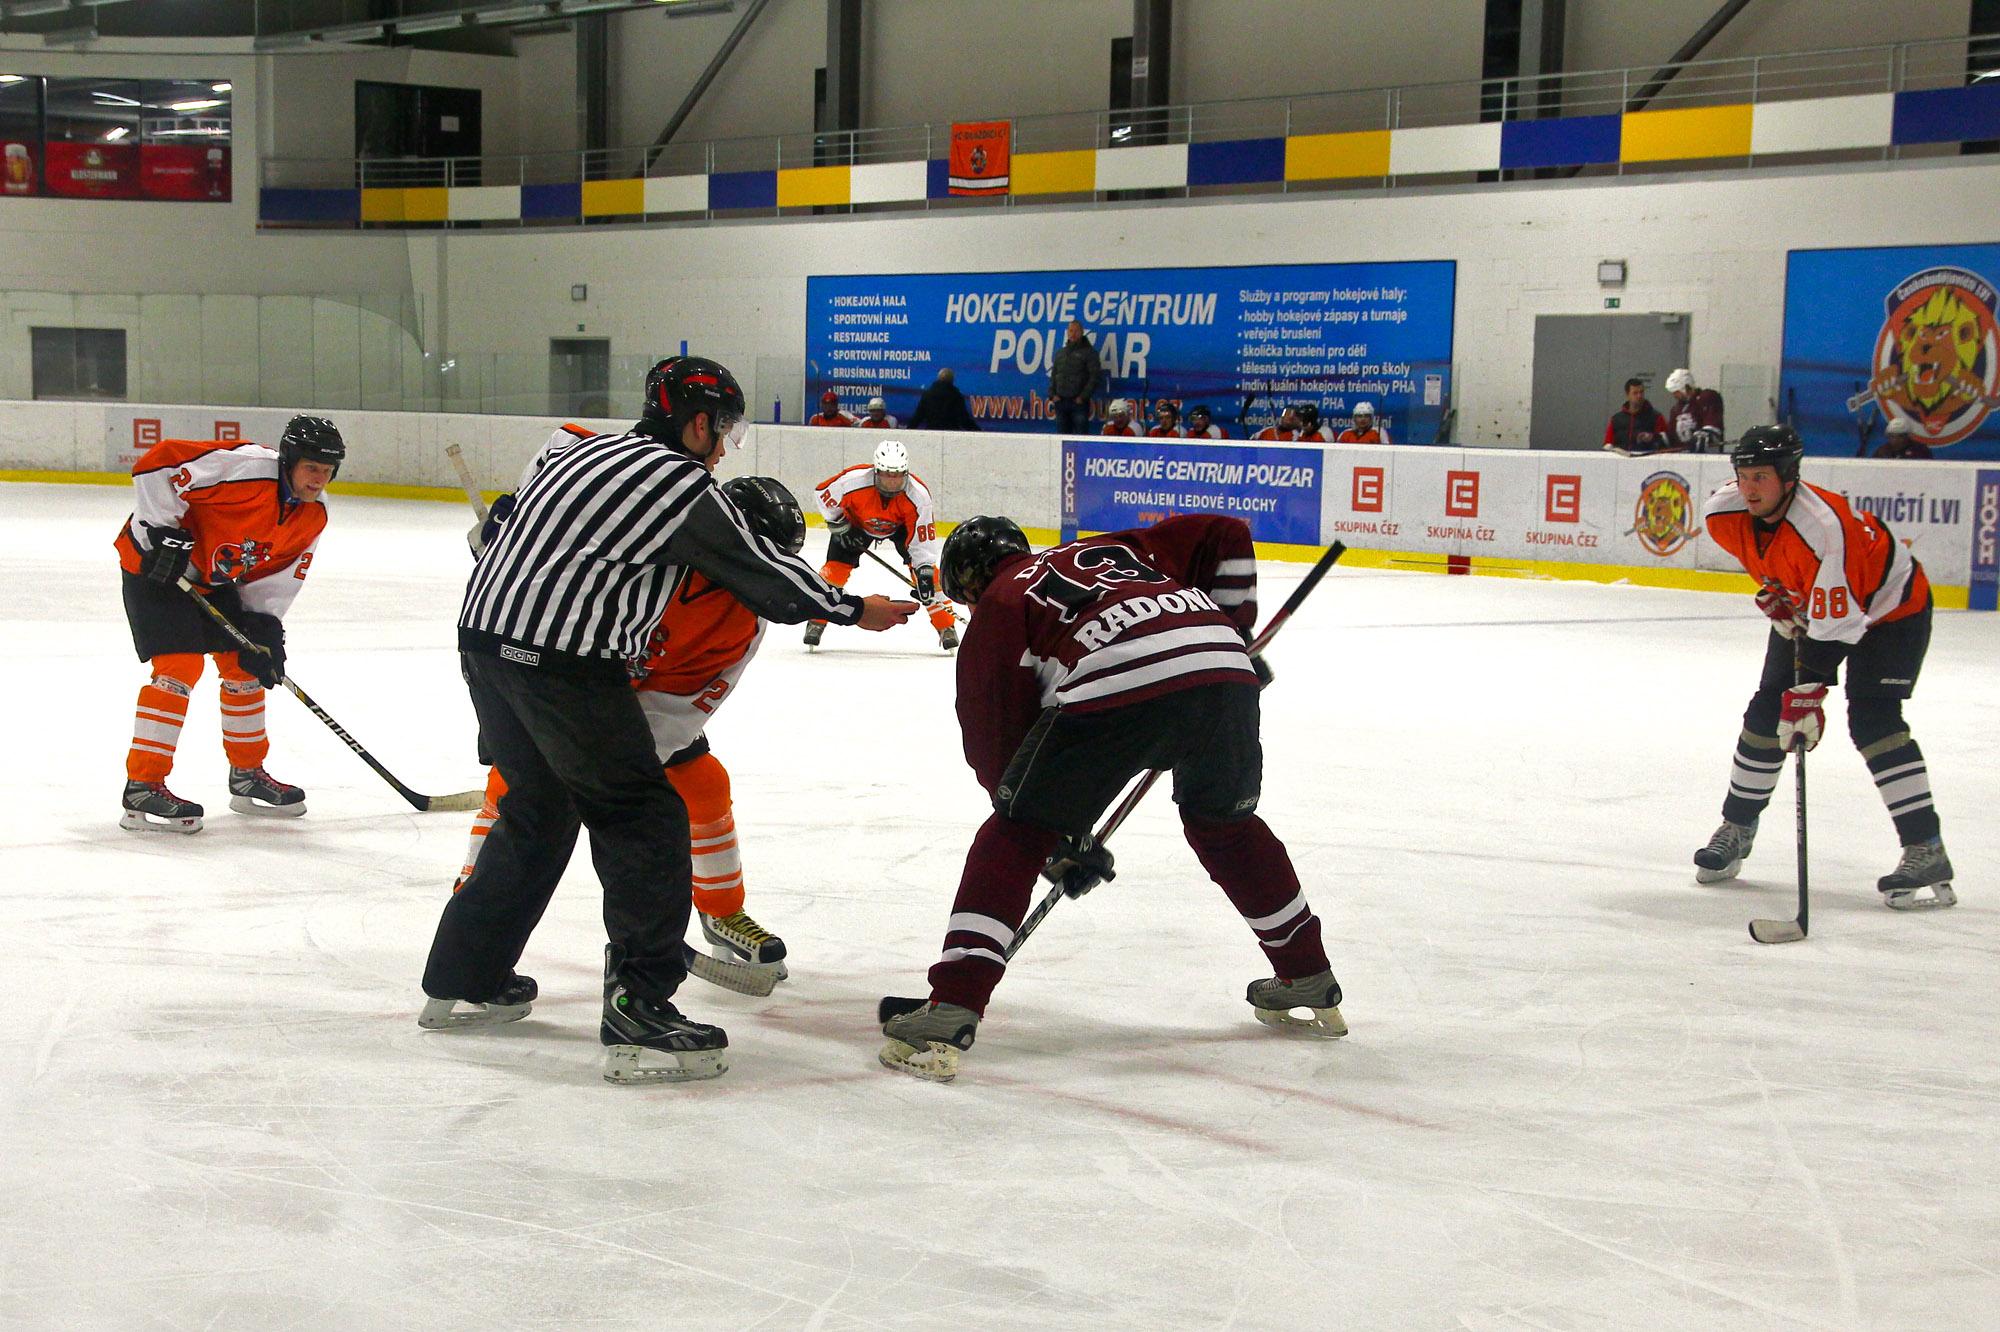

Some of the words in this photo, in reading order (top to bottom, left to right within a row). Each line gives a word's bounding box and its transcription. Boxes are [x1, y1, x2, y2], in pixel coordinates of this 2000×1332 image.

[834, 293, 881, 307] HOKEJOVÁ
[883, 295, 907, 307] HALA
[945, 284, 1078, 323] HOKEJOVÉ
[1083, 291, 1217, 325] CENTRUM
[1239, 289, 1272, 305] Služby
[1274, 292, 1281, 302] a
[1282, 290, 1330, 304] programy
[1332, 287, 1379, 303] hokejové
[1381, 287, 1407, 303] haly:
[833, 312, 883, 325] SPORTOVNÍ
[885, 314, 909, 325] HALA
[1243, 309, 1275, 325] hobby
[1276, 309, 1321, 325] hokejové
[1324, 308, 1359, 324] zápasy
[1361, 311, 1368, 321] a
[1370, 308, 1407, 324] turnaje
[833, 332, 890, 343] RESTAURACE
[1243, 326, 1279, 342] veřejné
[1281, 326, 1322, 339] bruslení
[833, 347, 882, 361] SPORTOVNÍ
[884, 350, 931, 361] PRODEJNA
[1243, 344, 1283, 358] školička
[1285, 344, 1325, 357] bruslení
[1327, 347, 1344, 359] pro
[1347, 344, 1367, 357] děti
[833, 366, 877, 378] BRUSÍRNA
[879, 367, 911, 379] BRUSLÍ
[1242, 362, 1277, 375] tělesná
[1279, 361, 1321, 376] výchova
[1323, 364, 1336, 375] na
[1338, 362, 1359, 375] ledě
[1362, 364, 1379, 378] pro
[1382, 361, 1411, 378] školy
[833, 385, 882, 396] UBYTOVÁNÍ
[1300, 379, 1346, 394] hokejové
[1348, 380, 1391, 396] tréninky
[1392, 380, 1416, 393] PHA
[1322, 397, 1345, 410] PHA
[1085, 456, 1163, 480] HOKEJOVÉ
[1166, 460, 1244, 484] CENTRUM
[1246, 464, 1314, 488] POUZAR
[1065, 452, 1075, 513] HOCH
[1114, 489, 1175, 506] PRONÁJEM
[1179, 493, 1225, 510] LEDOVÉ
[1228, 497, 1277, 512] PLOCHY
[1930, 499, 1960, 524] LVI
[1334, 521, 1377, 534] SKUPINA
[1380, 520, 1399, 536] ČEZ
[1427, 526, 1473, 540] SKUPINA
[1476, 525, 1495, 542] ČEZ
[1525, 531, 1574, 546] SKUPINA
[1577, 531, 1598, 547] ČEZ
[294, 552, 313, 581] 2
[1811, 587, 1848, 619] 88
[501, 646, 539, 664] CCM
